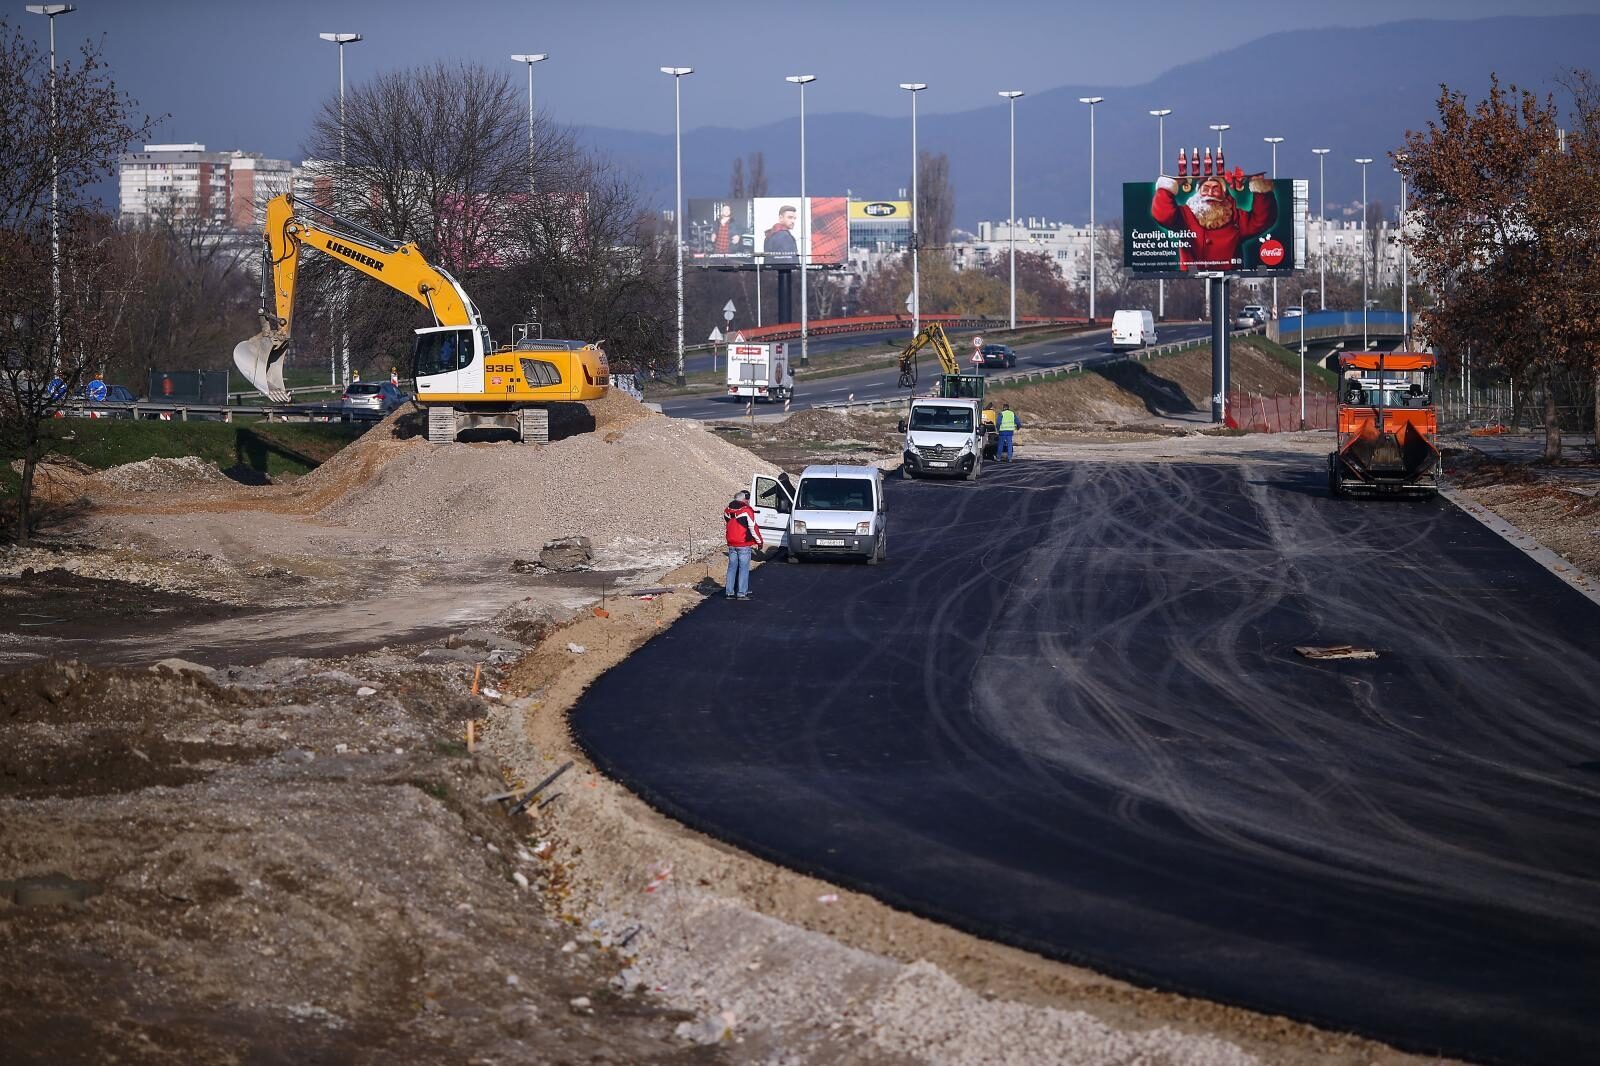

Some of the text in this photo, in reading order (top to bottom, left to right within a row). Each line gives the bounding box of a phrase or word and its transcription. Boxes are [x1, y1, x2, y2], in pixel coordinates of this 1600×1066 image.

[1132, 229, 1197, 240] Čarolija Božića
[1133, 240, 1192, 249] kreće od tebe.
[326, 240, 384, 272] LIEBHERR
[486, 365, 514, 373] 936
